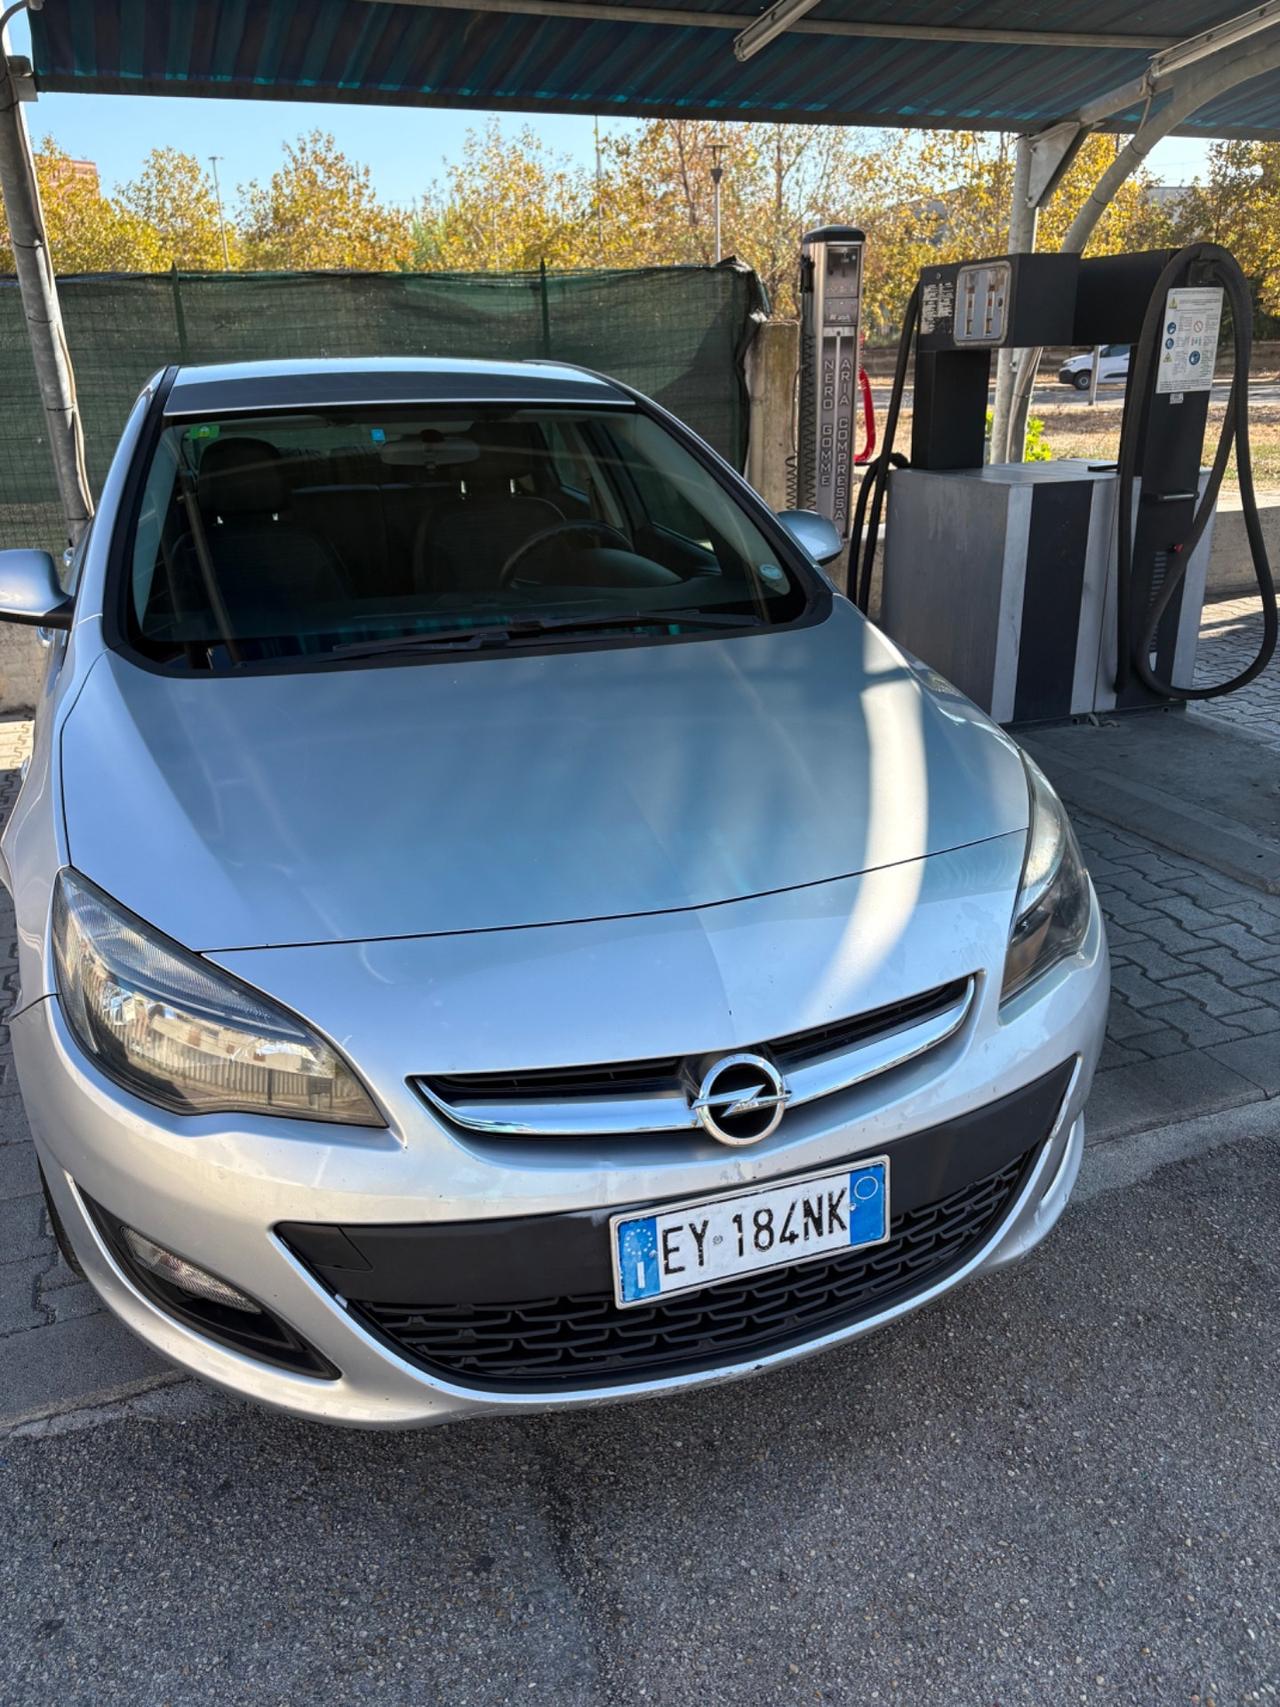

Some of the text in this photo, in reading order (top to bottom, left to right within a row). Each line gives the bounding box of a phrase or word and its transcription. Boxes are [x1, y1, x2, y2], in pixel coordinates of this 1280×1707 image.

[820, 360, 834, 486] NERO GOMME
[834, 360, 851, 520] ARIA COMPRESSA
[662, 1187, 848, 1275] EY 184NK
